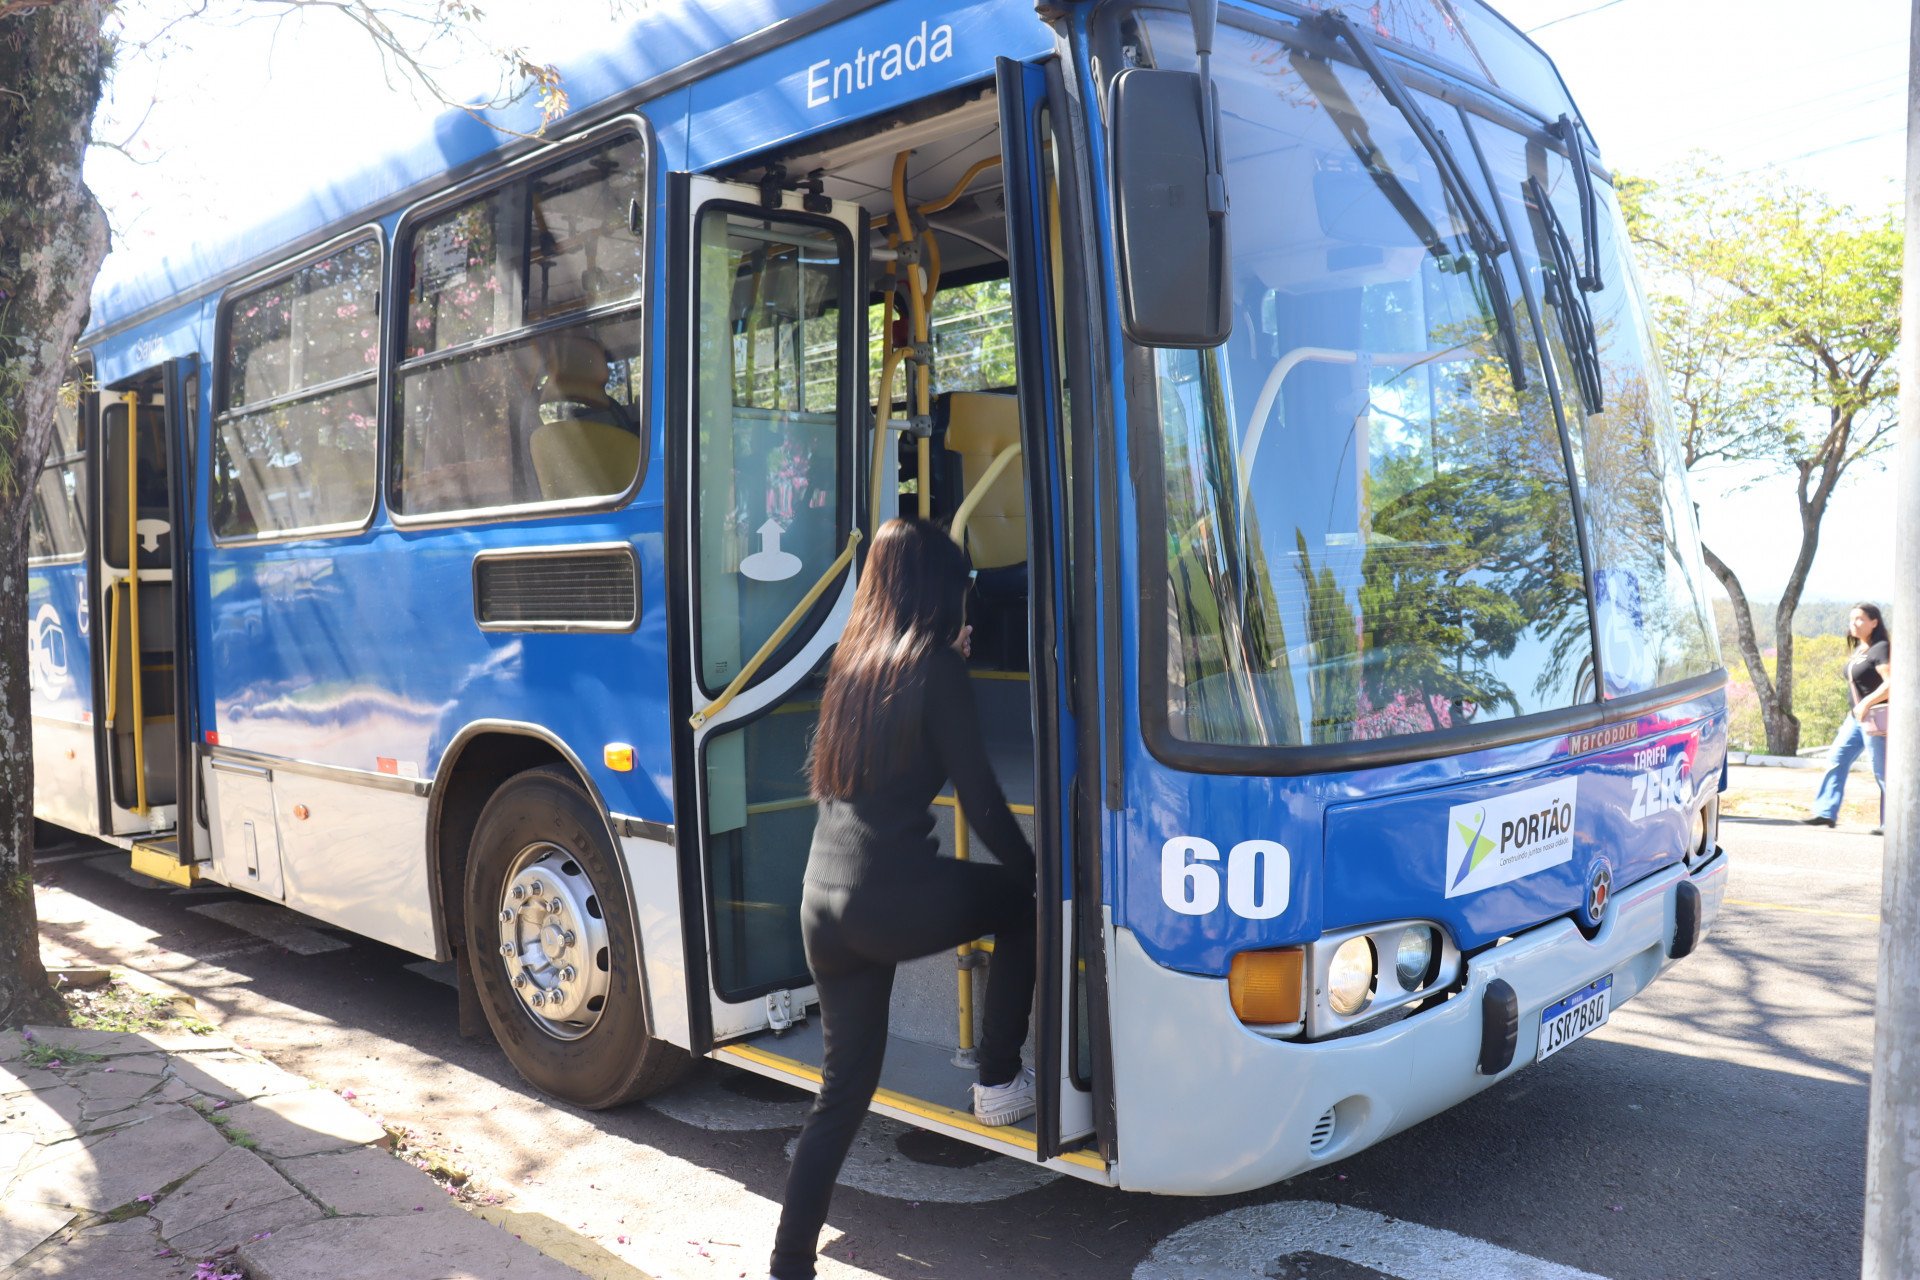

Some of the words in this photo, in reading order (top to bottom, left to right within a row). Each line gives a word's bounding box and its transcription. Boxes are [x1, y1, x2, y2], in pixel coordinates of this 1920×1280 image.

[807, 20, 953, 109] Entrada
[1571, 722, 1637, 755] Marcopolo
[1633, 745, 1667, 771] TARIFA
[1630, 751, 1692, 822] ZERO
[1500, 798, 1572, 854] PORTÃO
[1161, 836, 1290, 919] 60
[1499, 850, 1528, 867] Construindo
[1528, 846, 1543, 859] juntos
[1543, 842, 1555, 852] nossa
